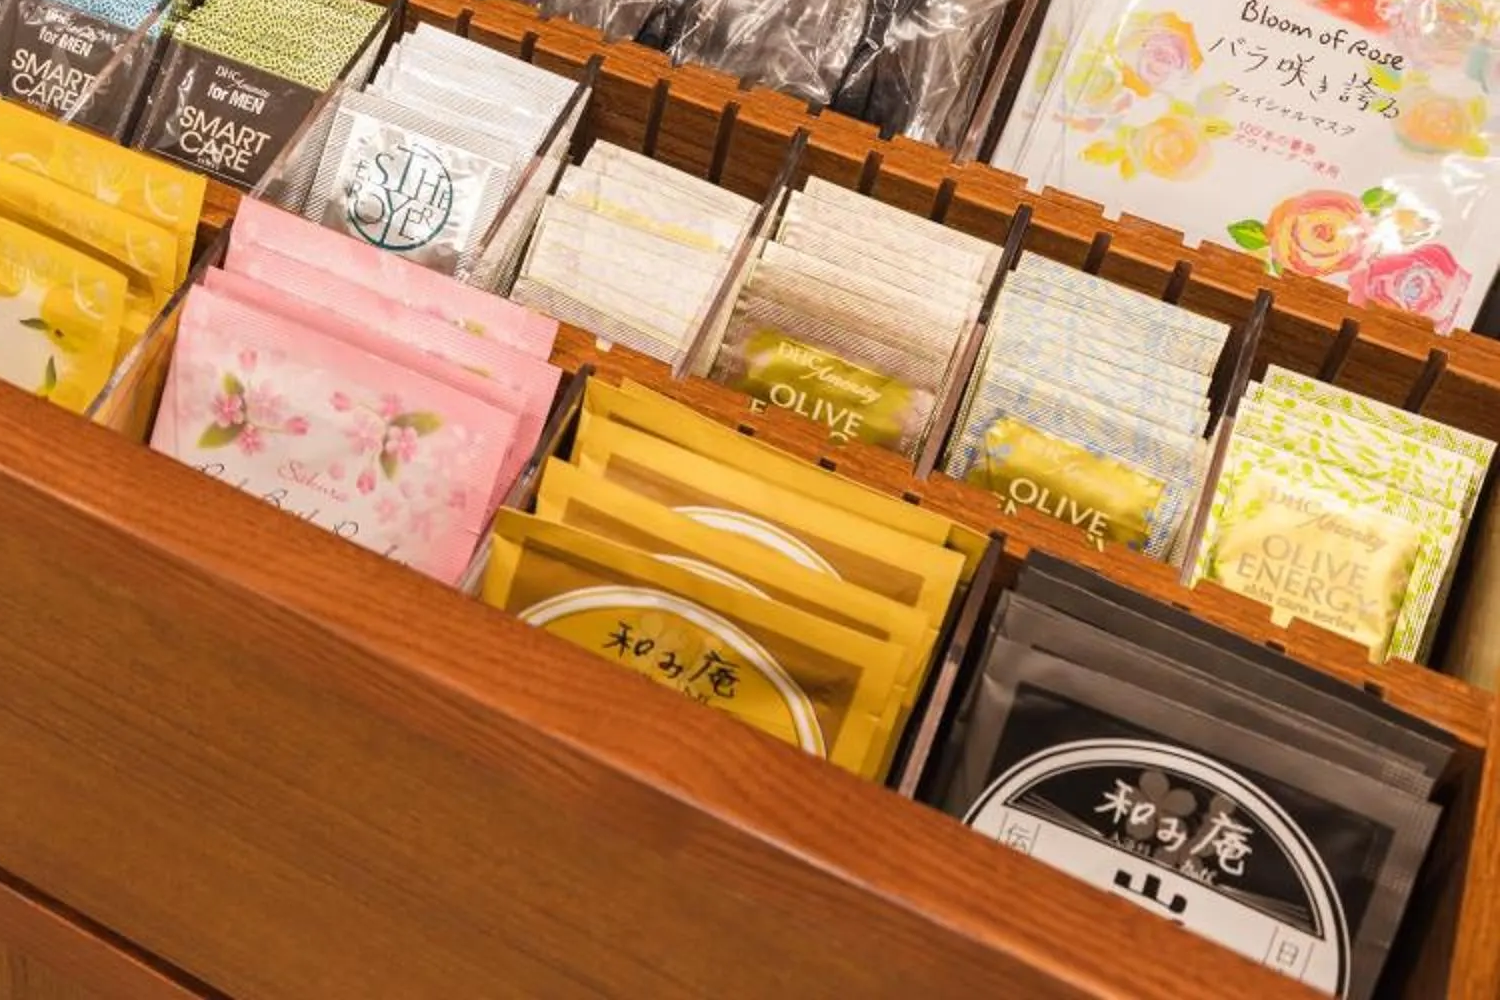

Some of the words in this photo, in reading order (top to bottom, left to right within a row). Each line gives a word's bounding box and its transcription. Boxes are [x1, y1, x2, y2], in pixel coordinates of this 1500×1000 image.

[38, 25, 60, 45] for
[58, 33, 94, 58] MEN
[1241, 0, 1312, 40] Bloom
[1319, 28, 1349, 49] of
[1347, 40, 1405, 70] Rose
[11, 47, 102, 94] SMART
[11, 72, 81, 111] CARE
[215, 65, 241, 81] DHC
[207, 82, 229, 101] for
[228, 89, 266, 115] MEN
[179, 105, 272, 155] SMART
[180, 130, 253, 173] CARE
[778, 340, 825, 370] DHC
[769, 382, 865, 438] OLIVE
[1008, 476, 1111, 537] OLIVE
[1235, 551, 1379, 616] ENERGY
[1261, 533, 1370, 592] OLIVE
[1093, 778, 1254, 877] 和み庵
